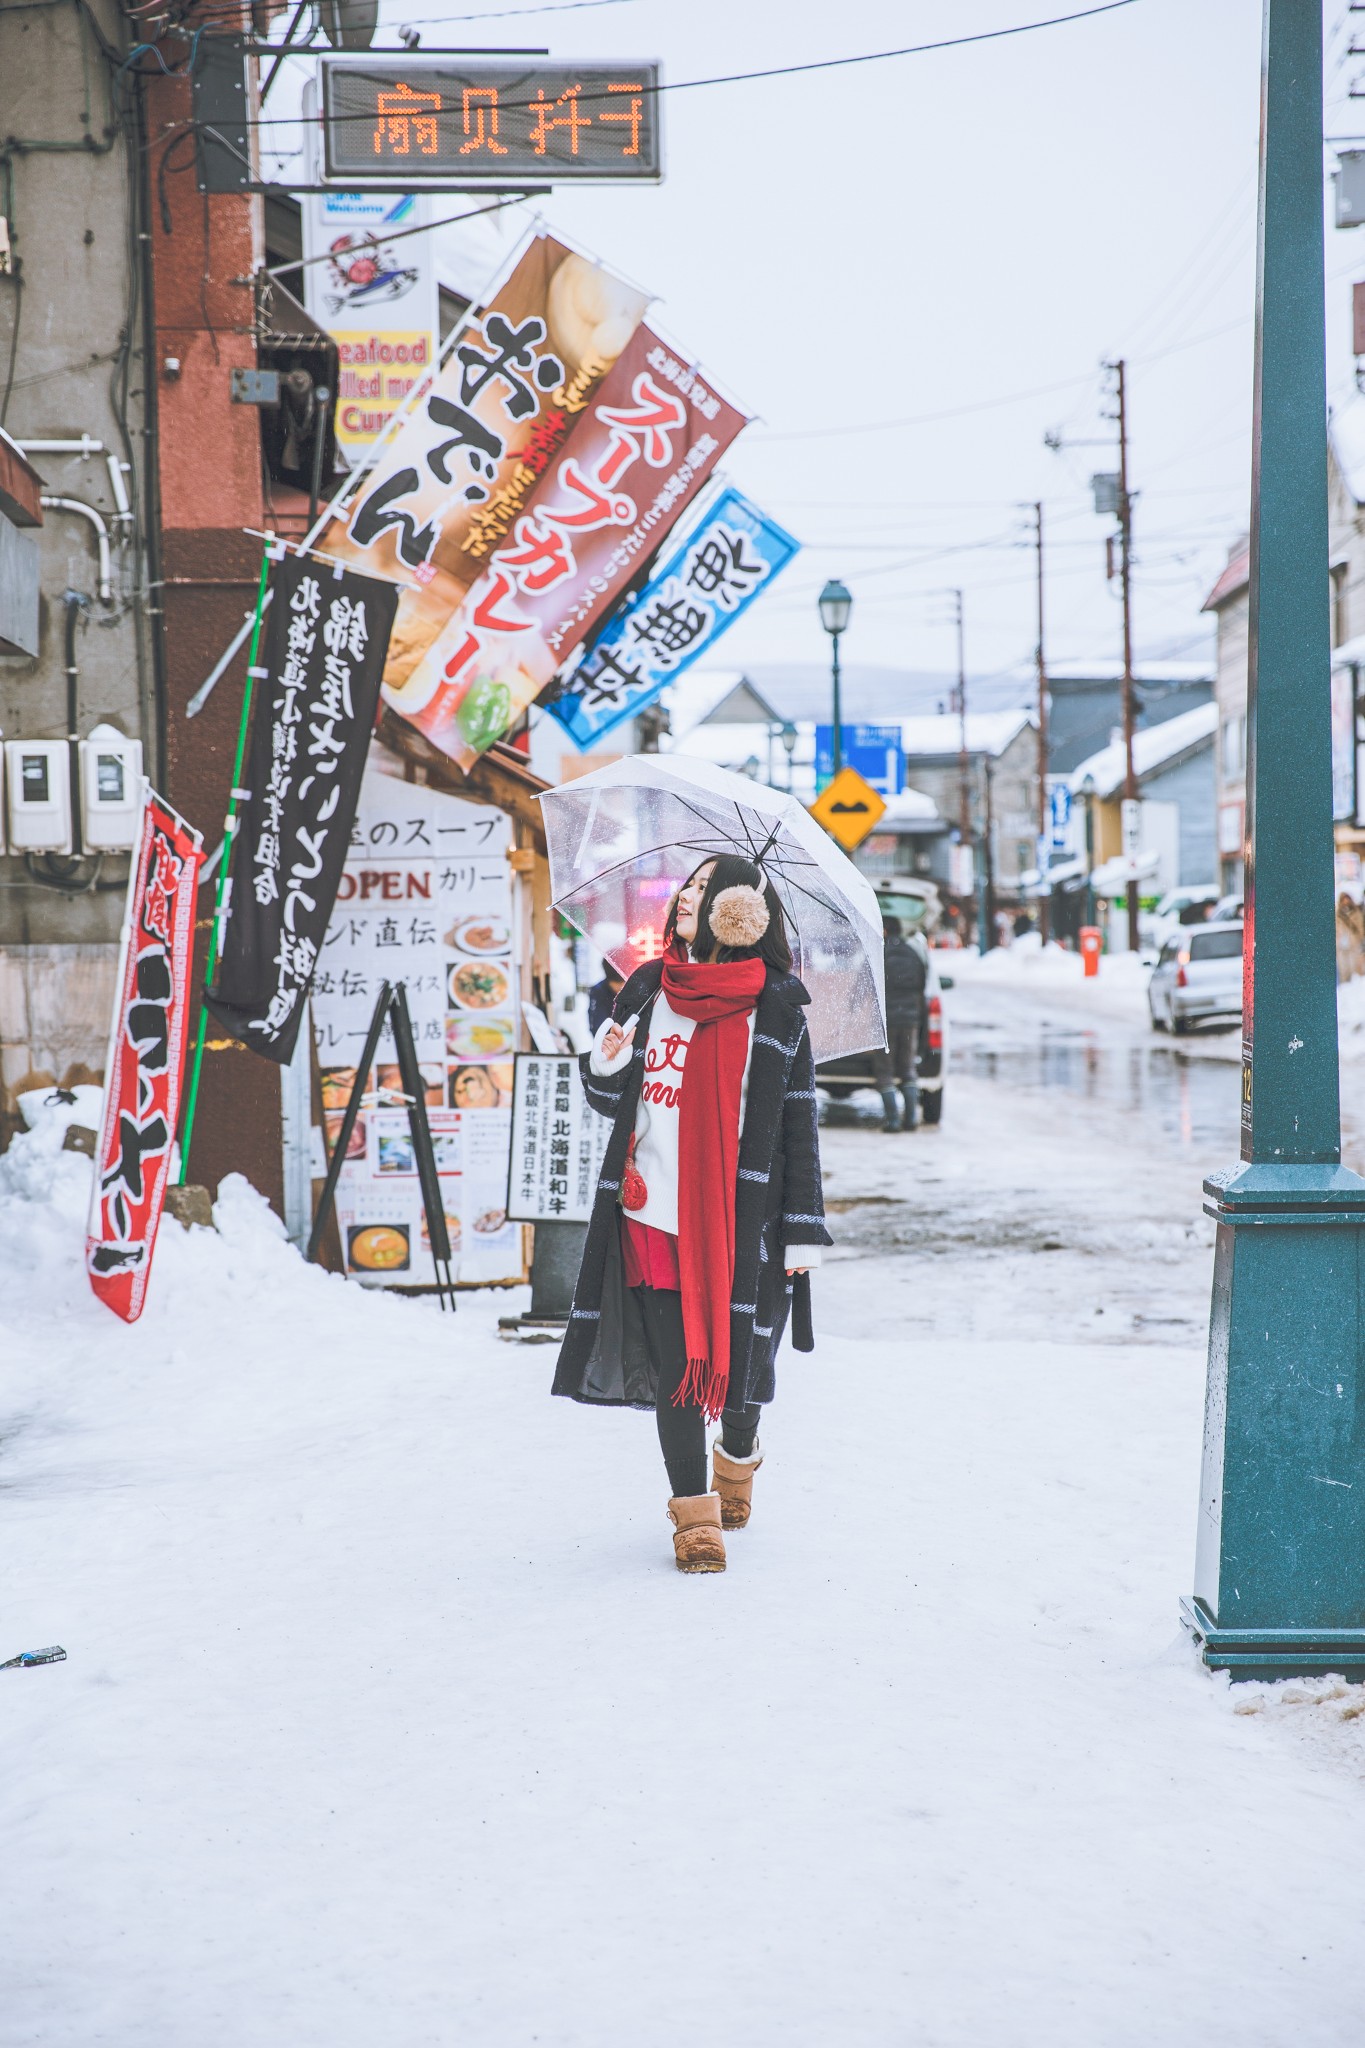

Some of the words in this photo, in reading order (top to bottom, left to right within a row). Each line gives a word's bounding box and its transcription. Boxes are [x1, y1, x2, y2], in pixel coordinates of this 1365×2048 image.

[338, 338, 426, 364] eafood
[338, 371, 380, 398] illed
[388, 376, 433, 398] me
[342, 406, 408, 437] Curr
[347, 311, 565, 570] おでん
[441, 370, 687, 683] スープカレー
[335, 871, 431, 900] OPEN
[439, 866, 504, 891] カリー
[521, 1062, 540, 1202] 最高級北海道日本牛
[548, 1119, 570, 1215] 北海道和牛
